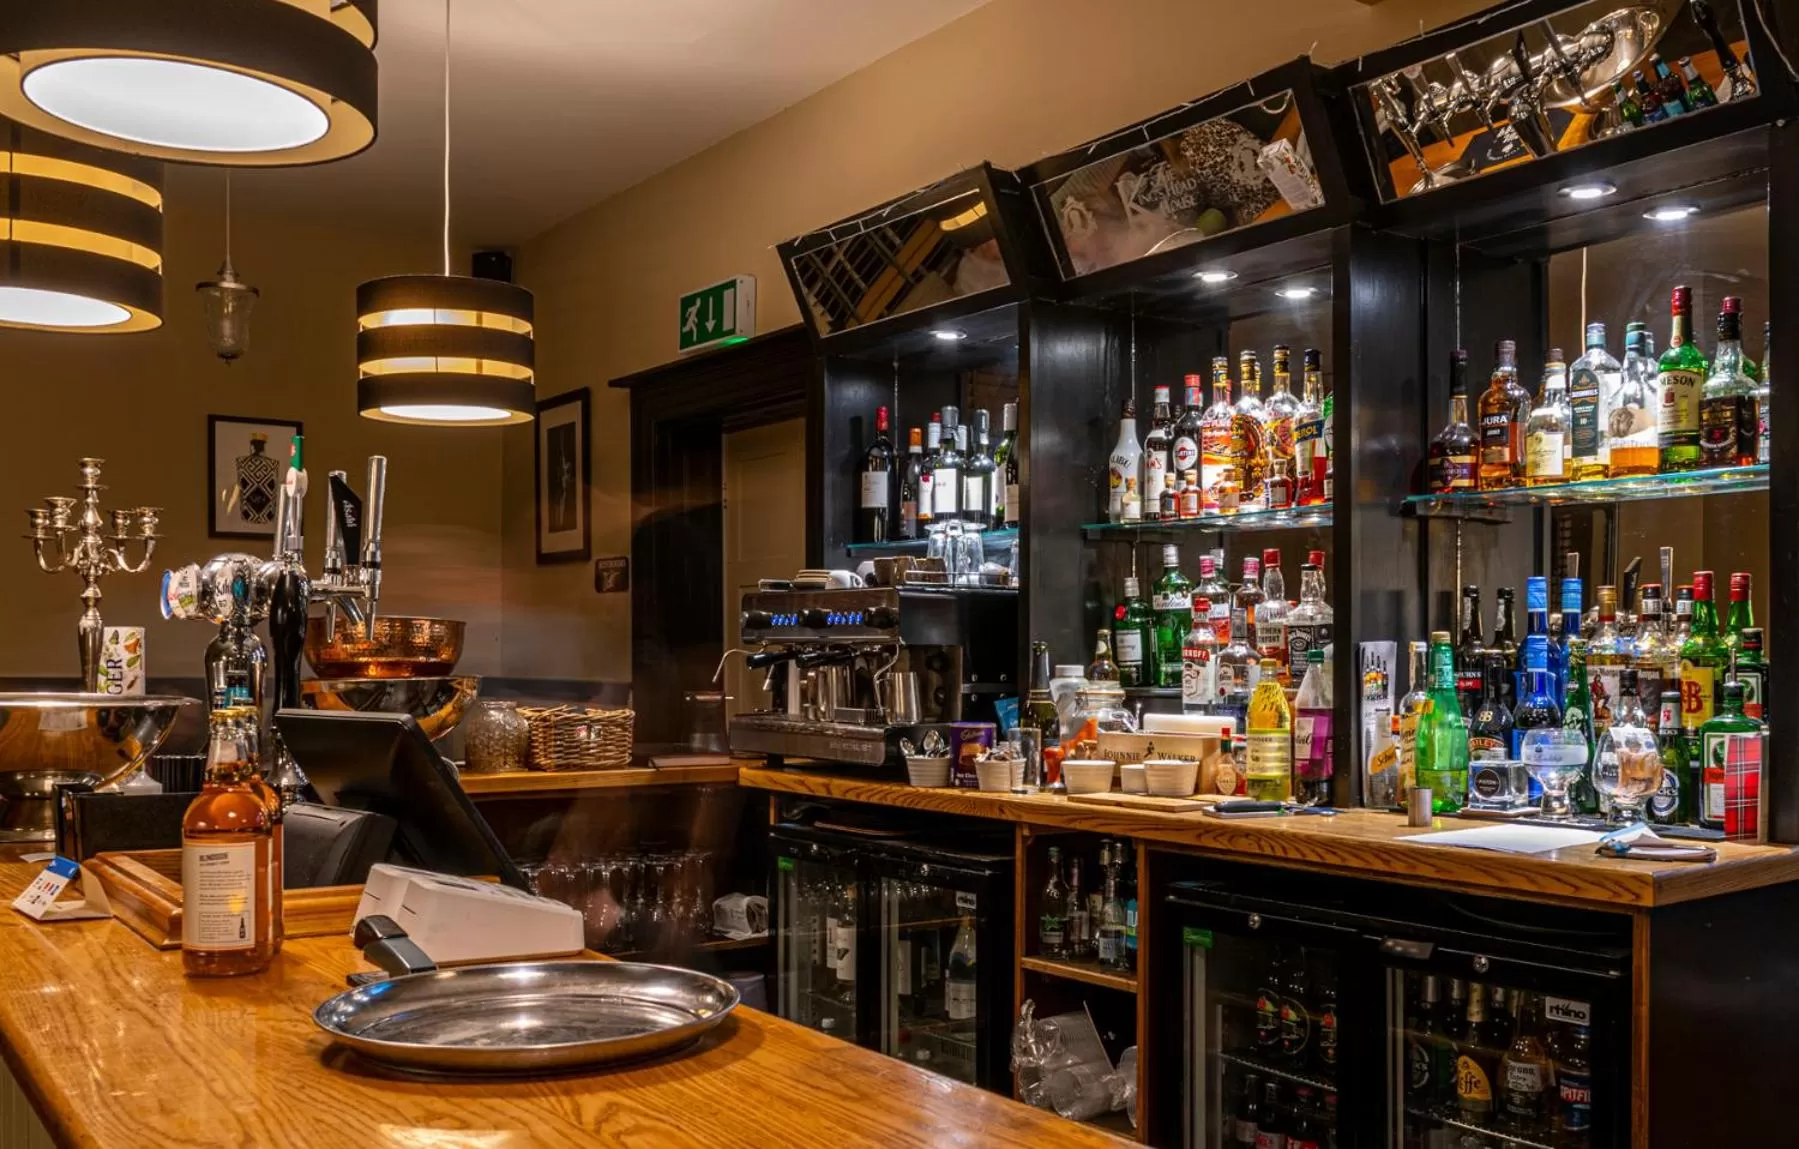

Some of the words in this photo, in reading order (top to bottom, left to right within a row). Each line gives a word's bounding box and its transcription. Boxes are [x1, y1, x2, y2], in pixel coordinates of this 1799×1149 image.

[1482, 414, 1509, 427] JURA
[342, 500, 359, 529] Asahi
[106, 659, 123, 694] GER
[1103, 749, 1141, 760] JOHNNIE
[1157, 751, 1197, 763] WALKER
[1550, 1003, 1587, 1020] rhino
[1459, 1072, 1481, 1094] effe
